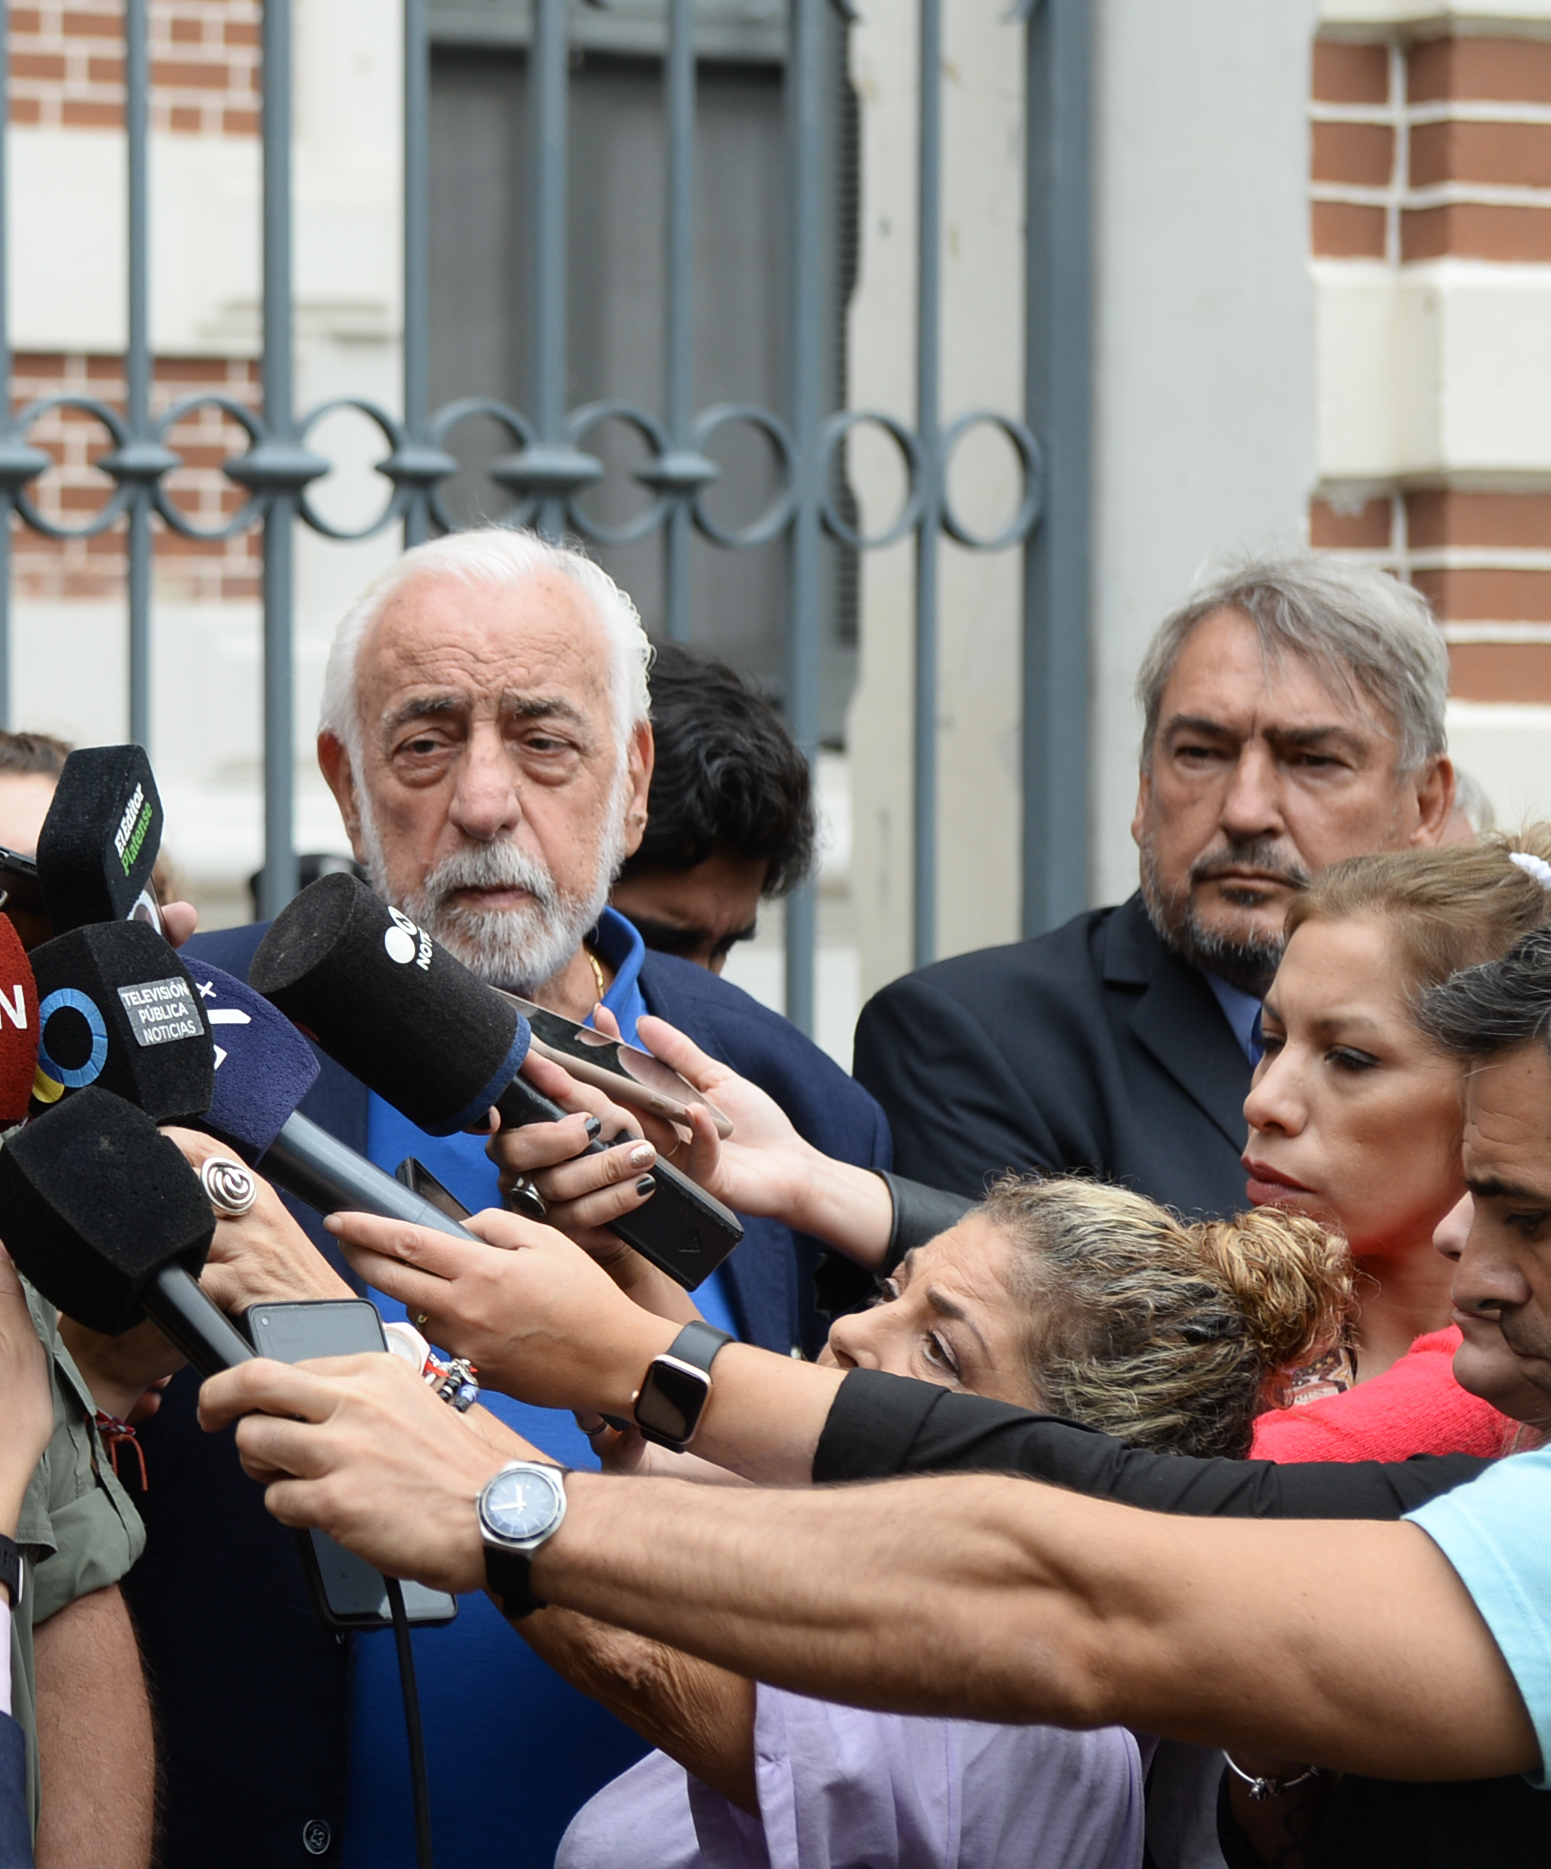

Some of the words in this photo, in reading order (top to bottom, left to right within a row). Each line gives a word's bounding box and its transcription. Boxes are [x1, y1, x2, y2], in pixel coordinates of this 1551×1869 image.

[121, 802, 153, 877] Platense
[121, 981, 190, 1006] TELEVISIÓN
[138, 1002, 189, 1023] PÚBLICA
[143, 1020, 197, 1044] NOTICIAS
